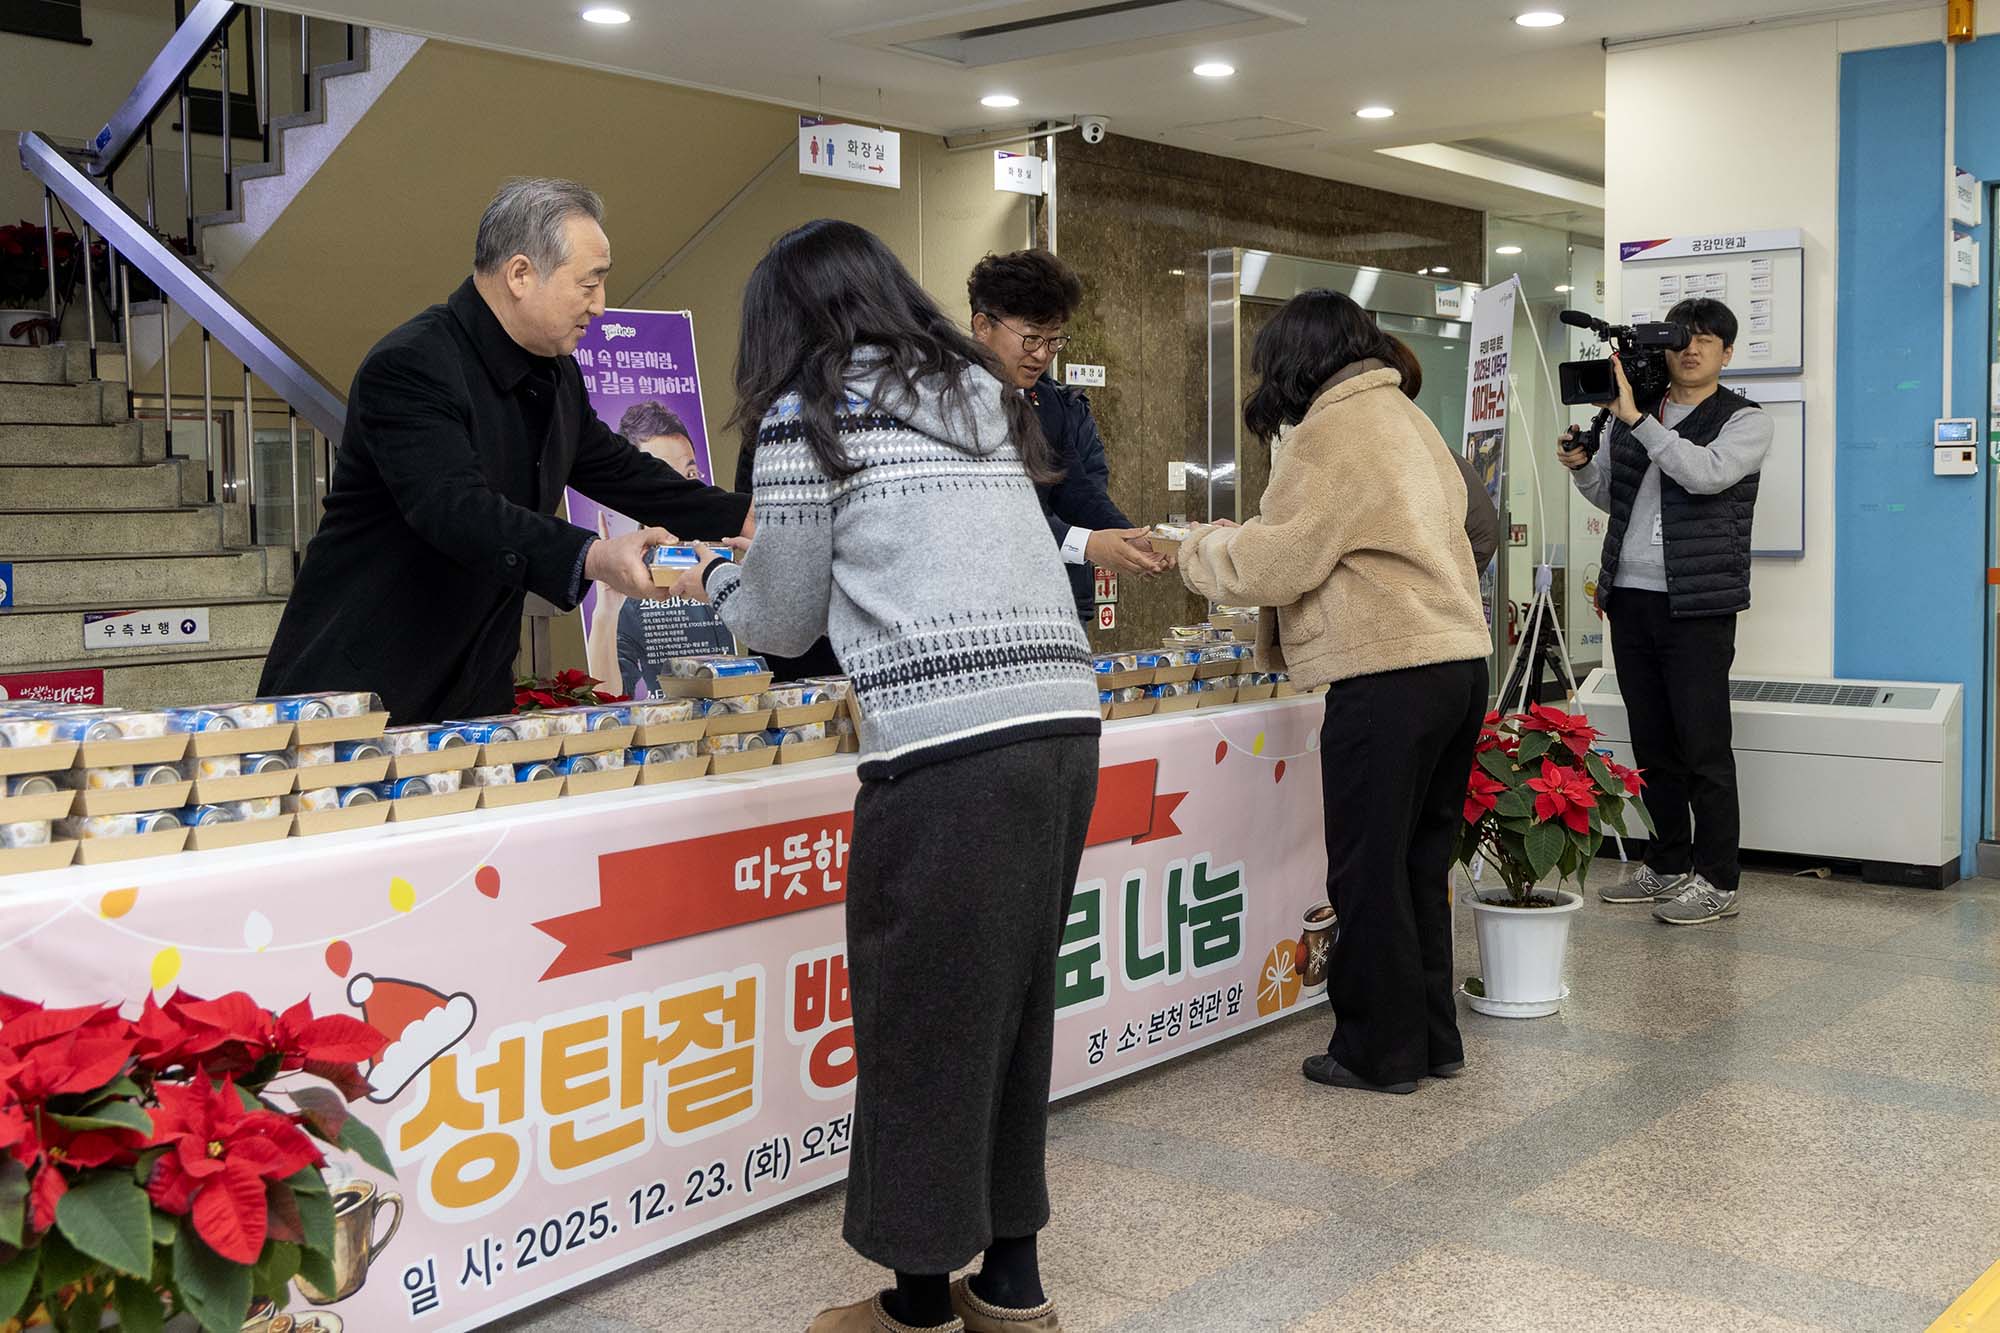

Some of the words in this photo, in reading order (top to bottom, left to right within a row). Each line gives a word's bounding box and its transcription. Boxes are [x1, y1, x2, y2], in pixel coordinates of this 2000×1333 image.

[847, 139, 884, 160] 화장실
[1692, 237, 1746, 251] 공감민원과
[597, 349, 612, 368] 속
[615, 350, 678, 371] 인물처럼,
[599, 371, 635, 395] 길을
[638, 376, 696, 395] 설계하라
[1471, 380, 1505, 422] 10대뉴스
[104, 621, 170, 637] 우측보행
[735, 829, 849, 900] 따뜻한
[400, 977, 756, 1208] 성탄절
[1125, 862, 1243, 980] 나눔
[1088, 1028, 1108, 1065] 장
[1116, 1022, 1143, 1052] 소:
[1148, 1003, 1184, 1044] 본청
[1189, 990, 1222, 1030] 현관
[1226, 983, 1244, 1016] 앞
[404, 1258, 439, 1315] 일
[460, 1238, 502, 1285] 시:
[516, 1201, 618, 1268] 2025.
[629, 1183, 674, 1224] 12.
[685, 1162, 732, 1206] 23.
[744, 1137, 791, 1192] (화)
[799, 1113, 852, 1163] 오전
